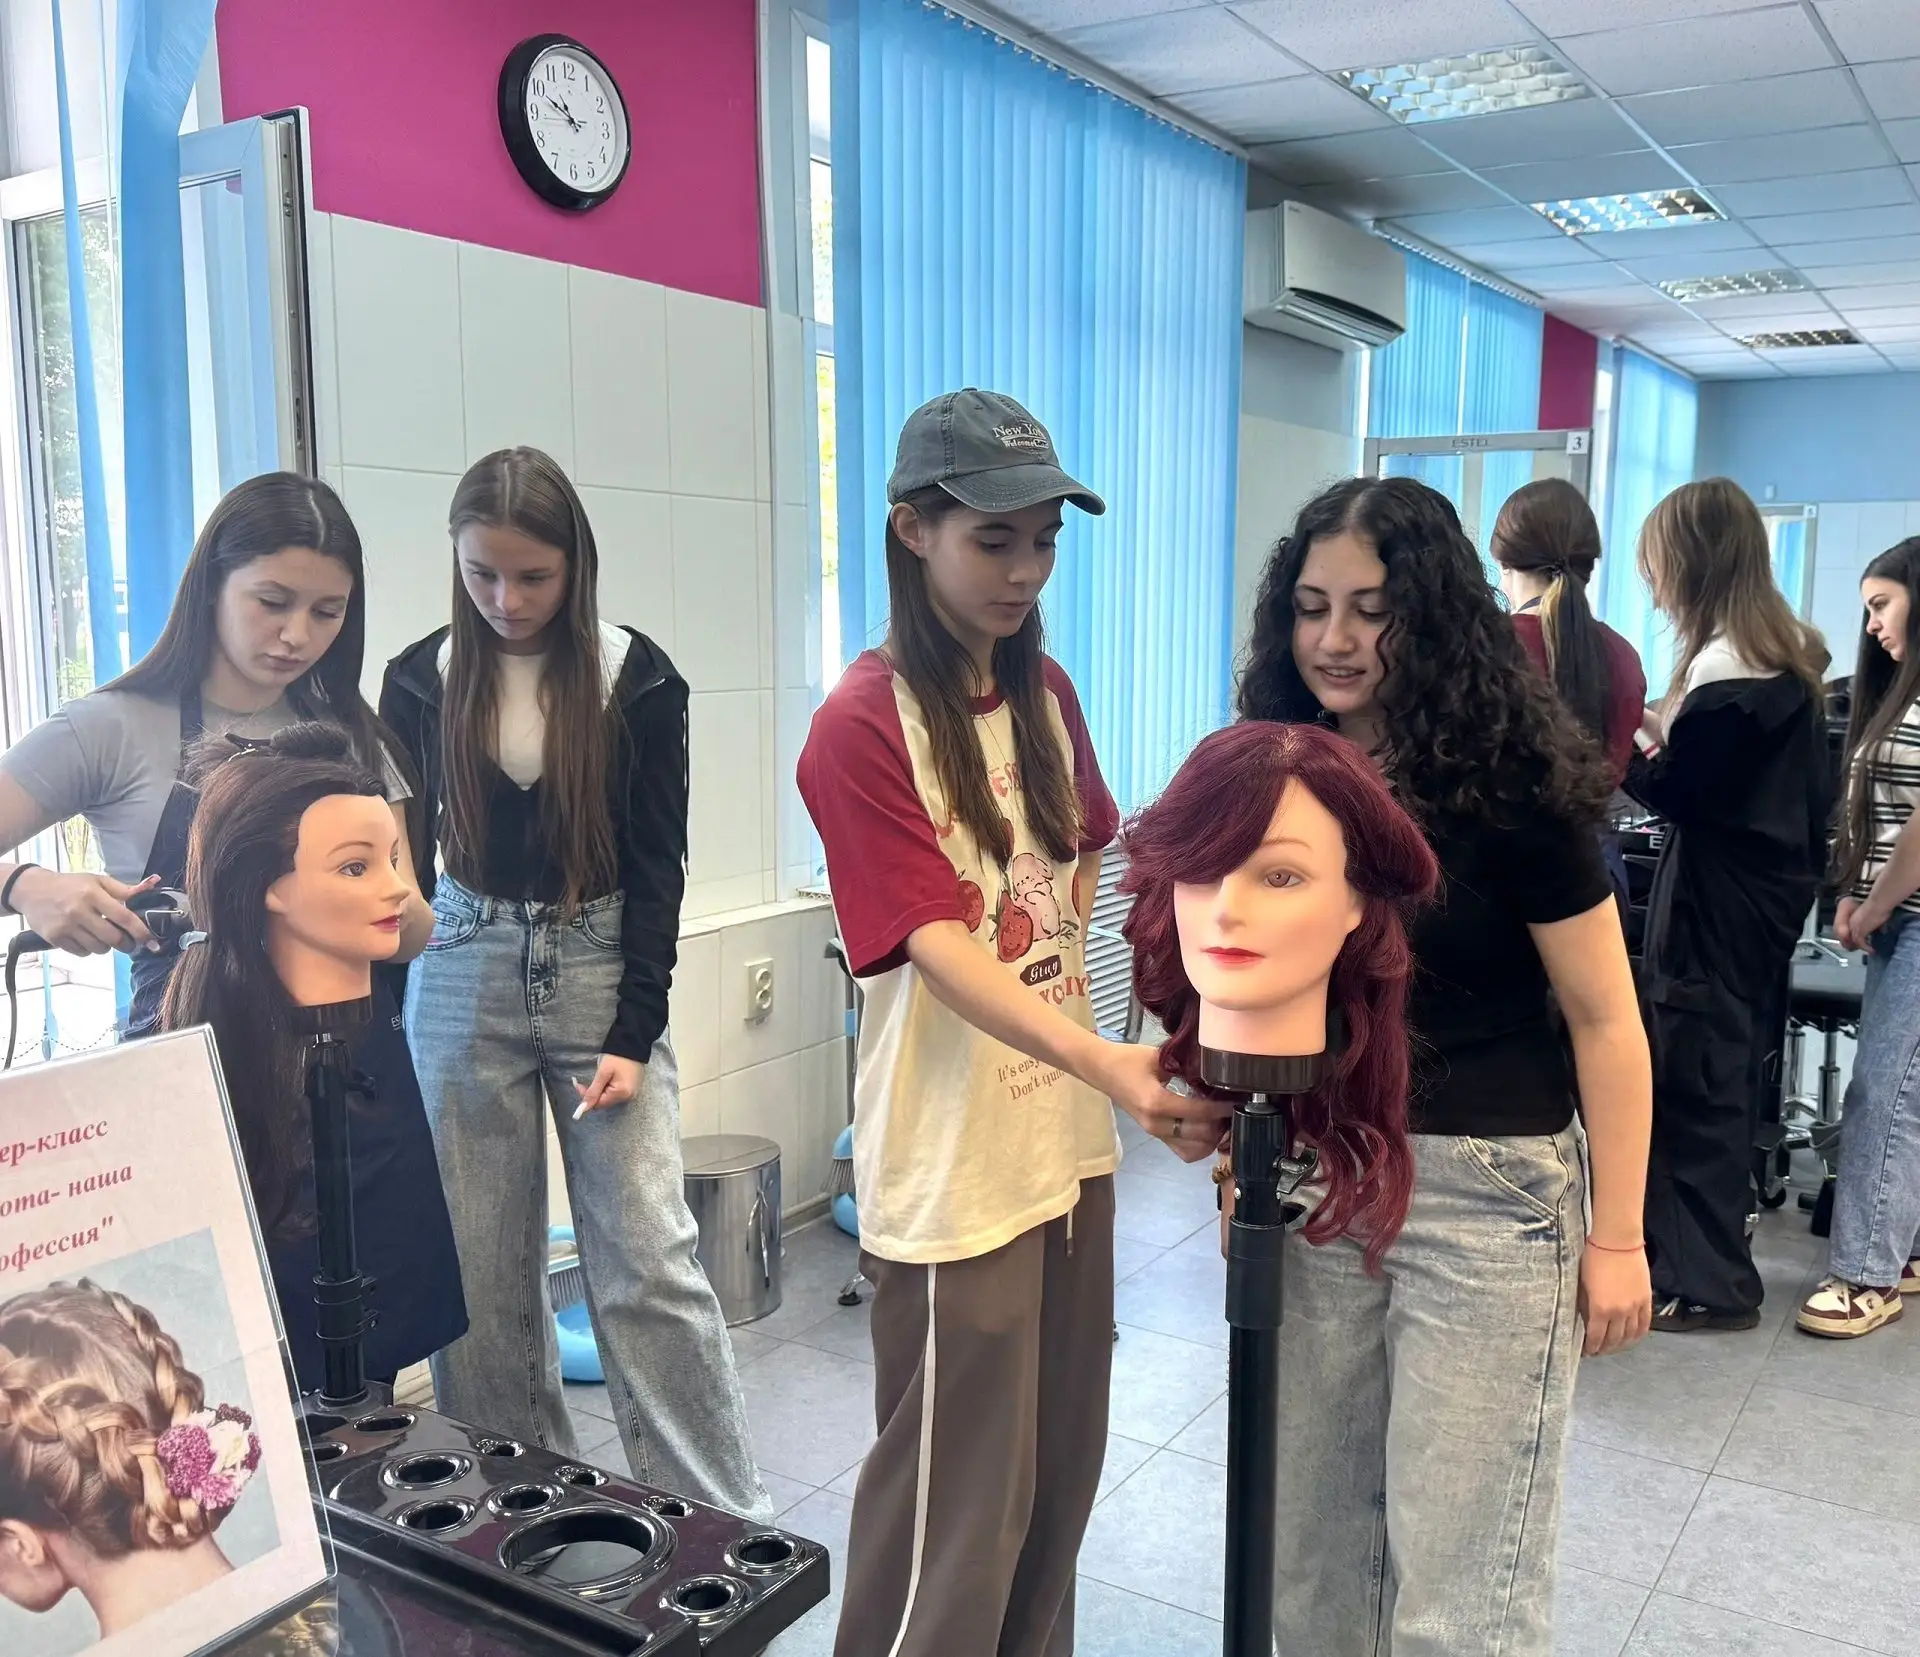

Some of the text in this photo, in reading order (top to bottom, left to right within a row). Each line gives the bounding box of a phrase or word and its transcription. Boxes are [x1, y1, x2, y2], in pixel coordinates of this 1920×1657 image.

[545, 63, 557, 83] 11
[561, 61, 576, 82] 12
[532, 78, 546, 97] 10
[584, 74, 590, 92] 1
[530, 103, 539, 121] 9
[595, 96, 604, 114] 2
[536, 131, 545, 148] 8
[602, 123, 610, 140] 3
[550, 152, 559, 170] 7
[598, 146, 606, 164] 4
[570, 163, 578, 181] 6
[587, 161, 595, 178] 5
[992, 425, 1021, 438] New
[1573, 436, 1582, 451] 3
[1009, 1075, 1041, 1100] Don't
[68, 1165, 133, 1198] наша
